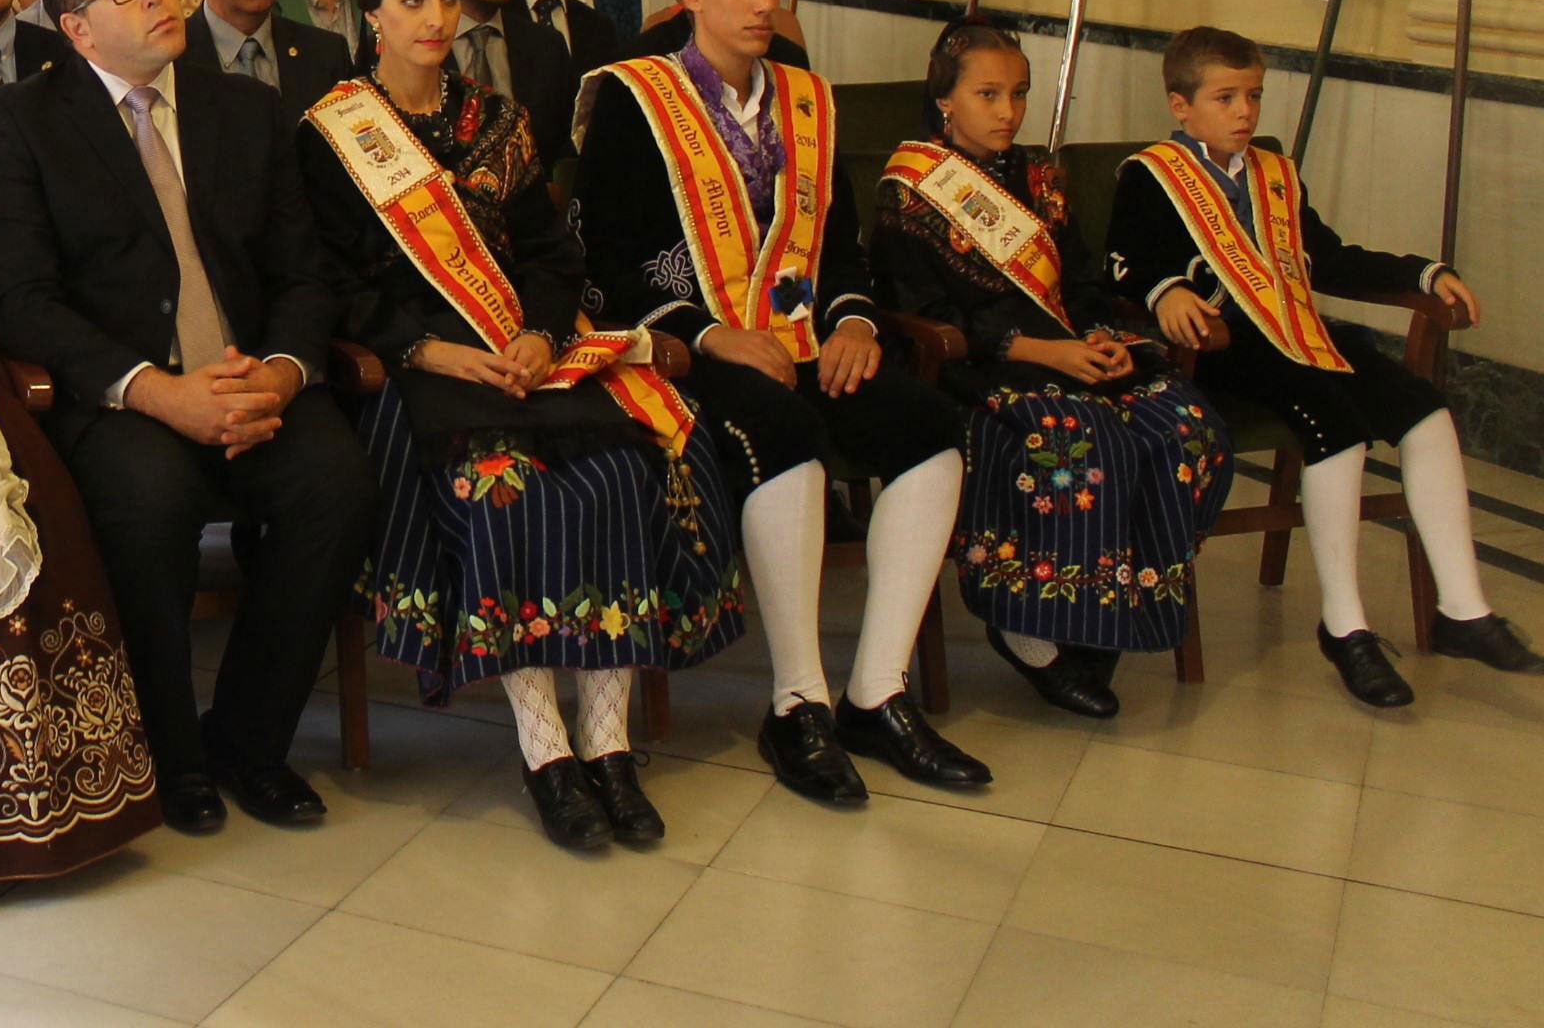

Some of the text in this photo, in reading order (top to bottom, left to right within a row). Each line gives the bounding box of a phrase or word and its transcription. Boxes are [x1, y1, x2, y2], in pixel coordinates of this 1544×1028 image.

[386, 167, 412, 187] 2014
[644, 65, 733, 238] Vendimiador Mayor
[999, 225, 1021, 247] 2014
[1168, 155, 1269, 292] Vendimiador Infantil
